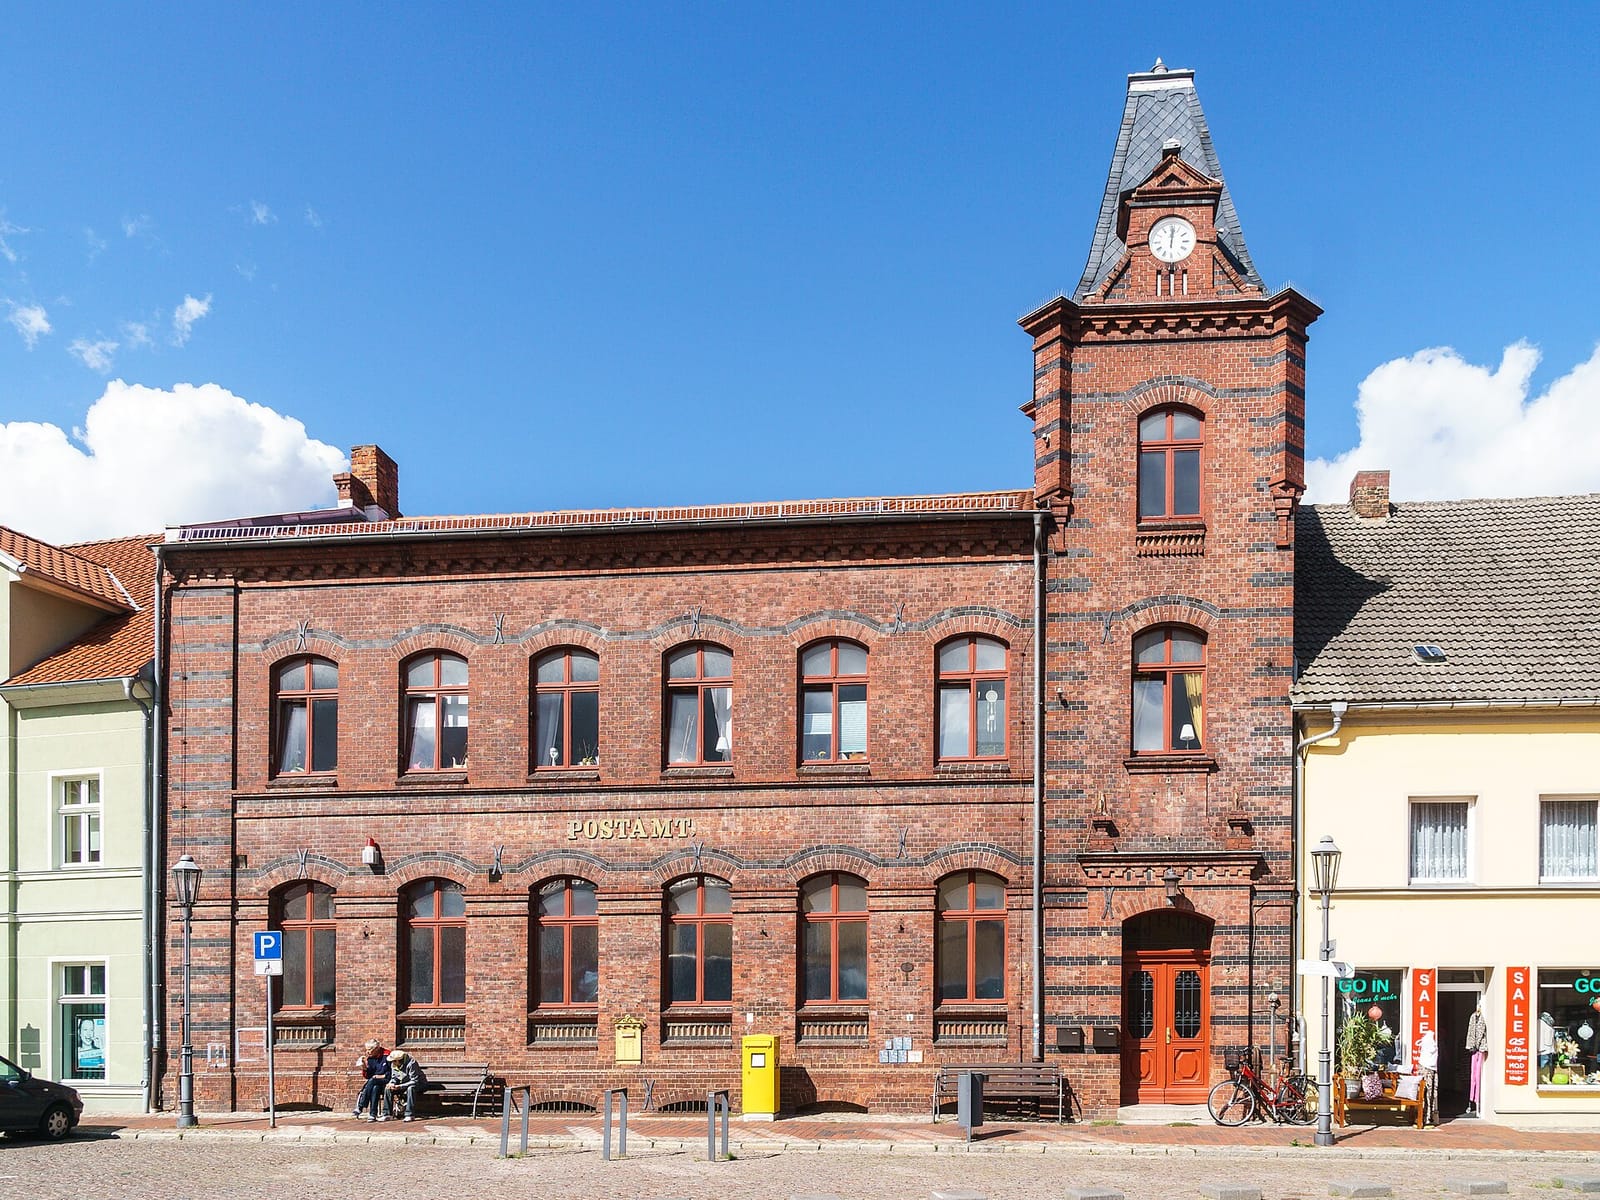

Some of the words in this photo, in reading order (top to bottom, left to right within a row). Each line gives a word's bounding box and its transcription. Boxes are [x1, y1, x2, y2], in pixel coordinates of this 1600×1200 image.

[260, 935, 276, 957] P
[1338, 978, 1367, 993] GO
[1371, 978, 1389, 993] IN
[1418, 973, 1430, 1034] SALE
[1512, 971, 1525, 1033] SALE
